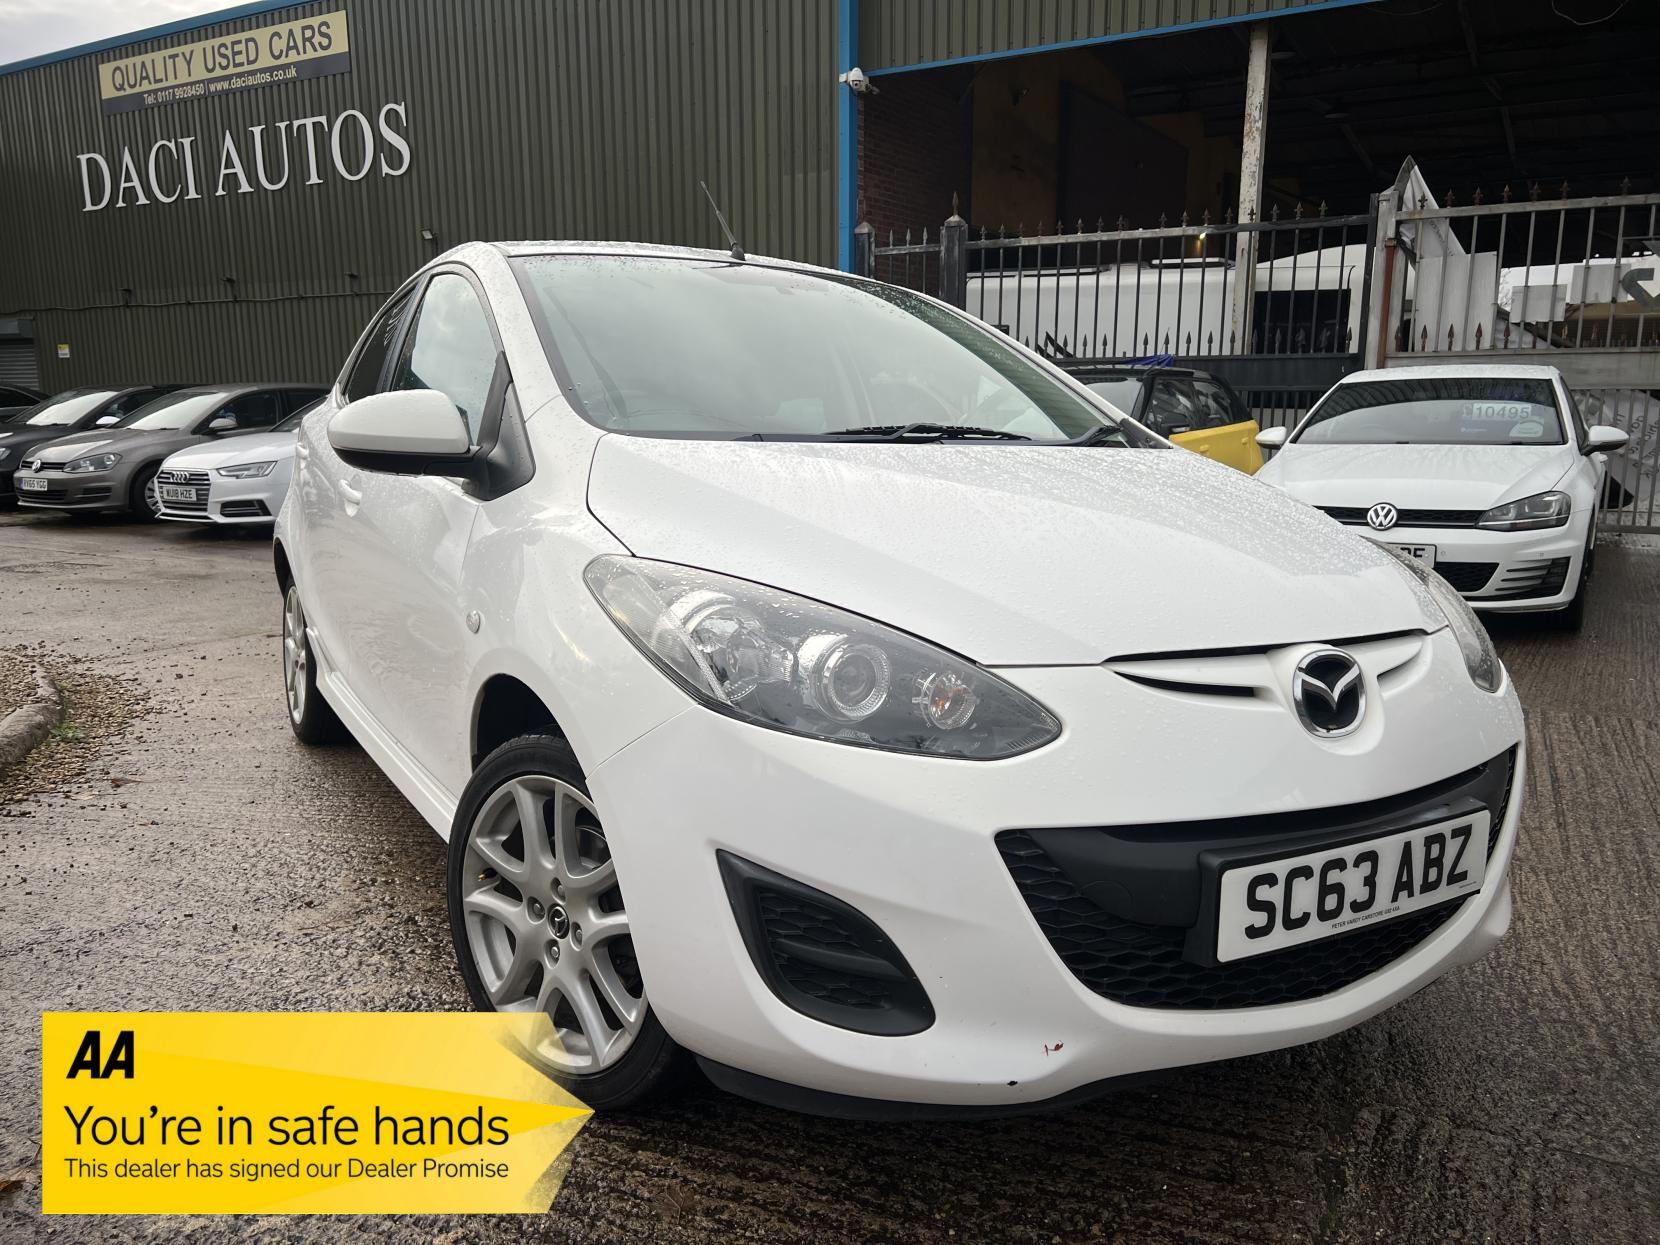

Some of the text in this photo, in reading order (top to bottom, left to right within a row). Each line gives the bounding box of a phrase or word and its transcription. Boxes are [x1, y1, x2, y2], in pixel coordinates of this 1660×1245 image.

[112, 20, 332, 93] QUALITY USED CARS
[143, 65, 297, 105] Tel: 0117 9928450 www.daciautos.co.uk
[77, 101, 411, 212] DACI AUTOS
[1244, 823, 1473, 940] SC63 ABZ
